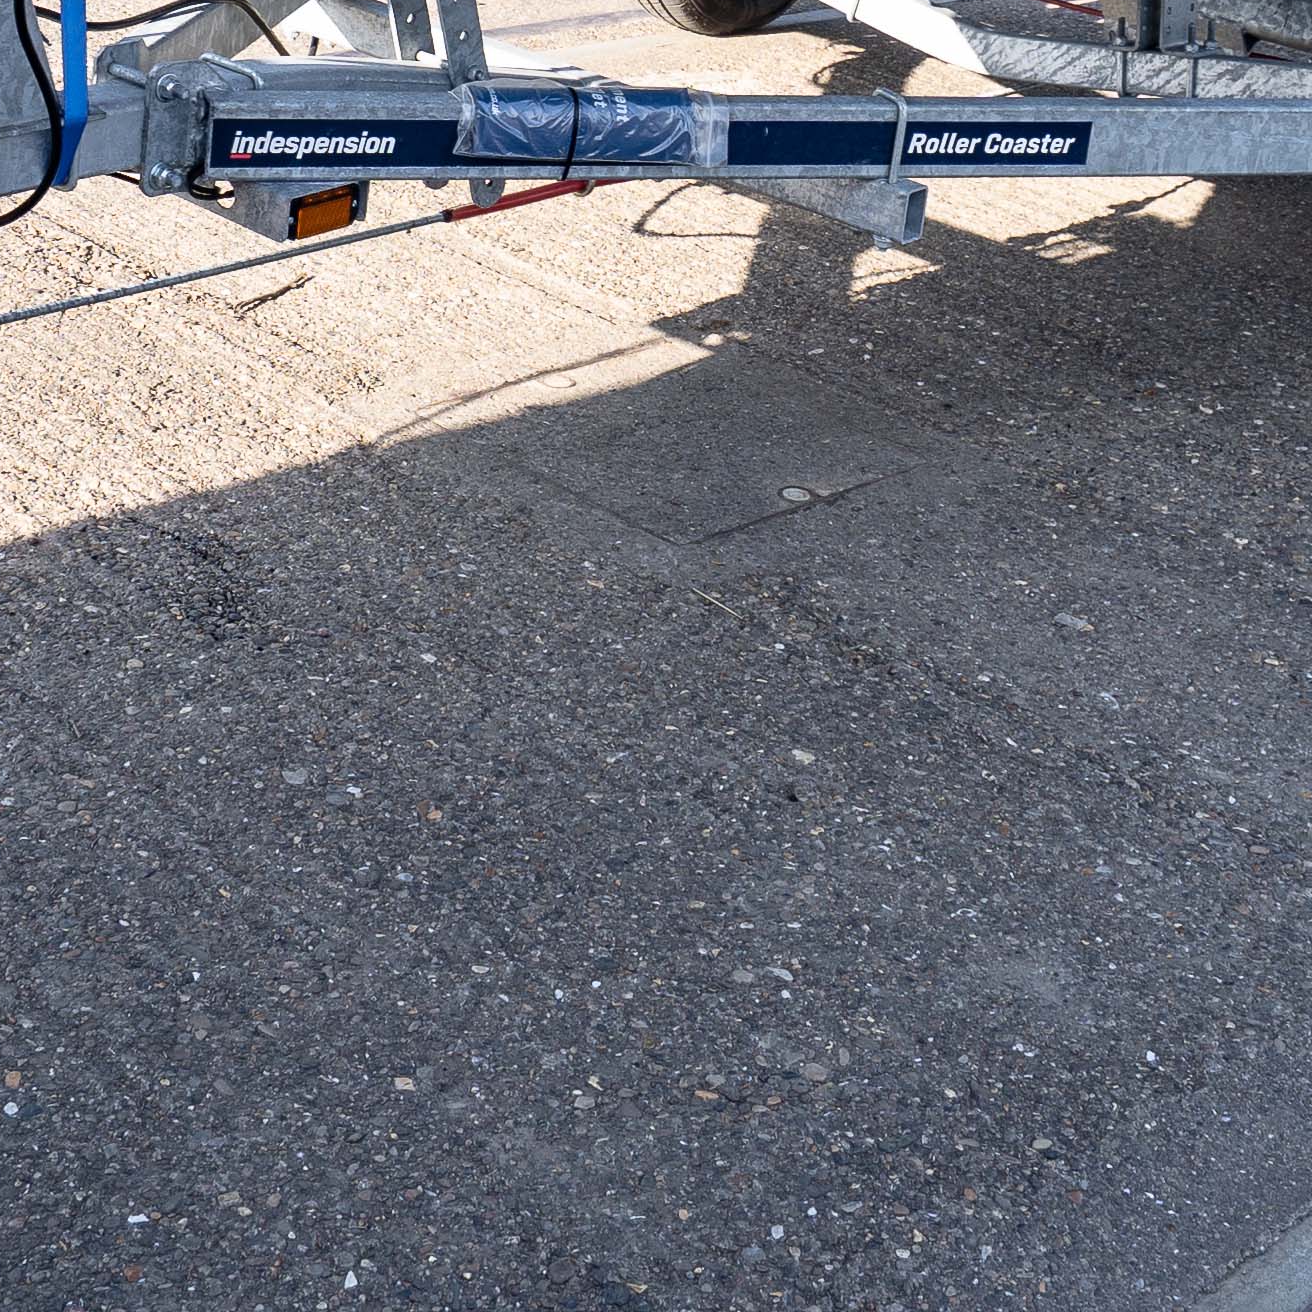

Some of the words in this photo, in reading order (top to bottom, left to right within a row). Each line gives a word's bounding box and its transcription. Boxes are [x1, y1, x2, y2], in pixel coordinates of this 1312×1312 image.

[230, 131, 396, 159] indespension
[907, 132, 981, 154] Roller
[984, 133, 1076, 154] Coaster
